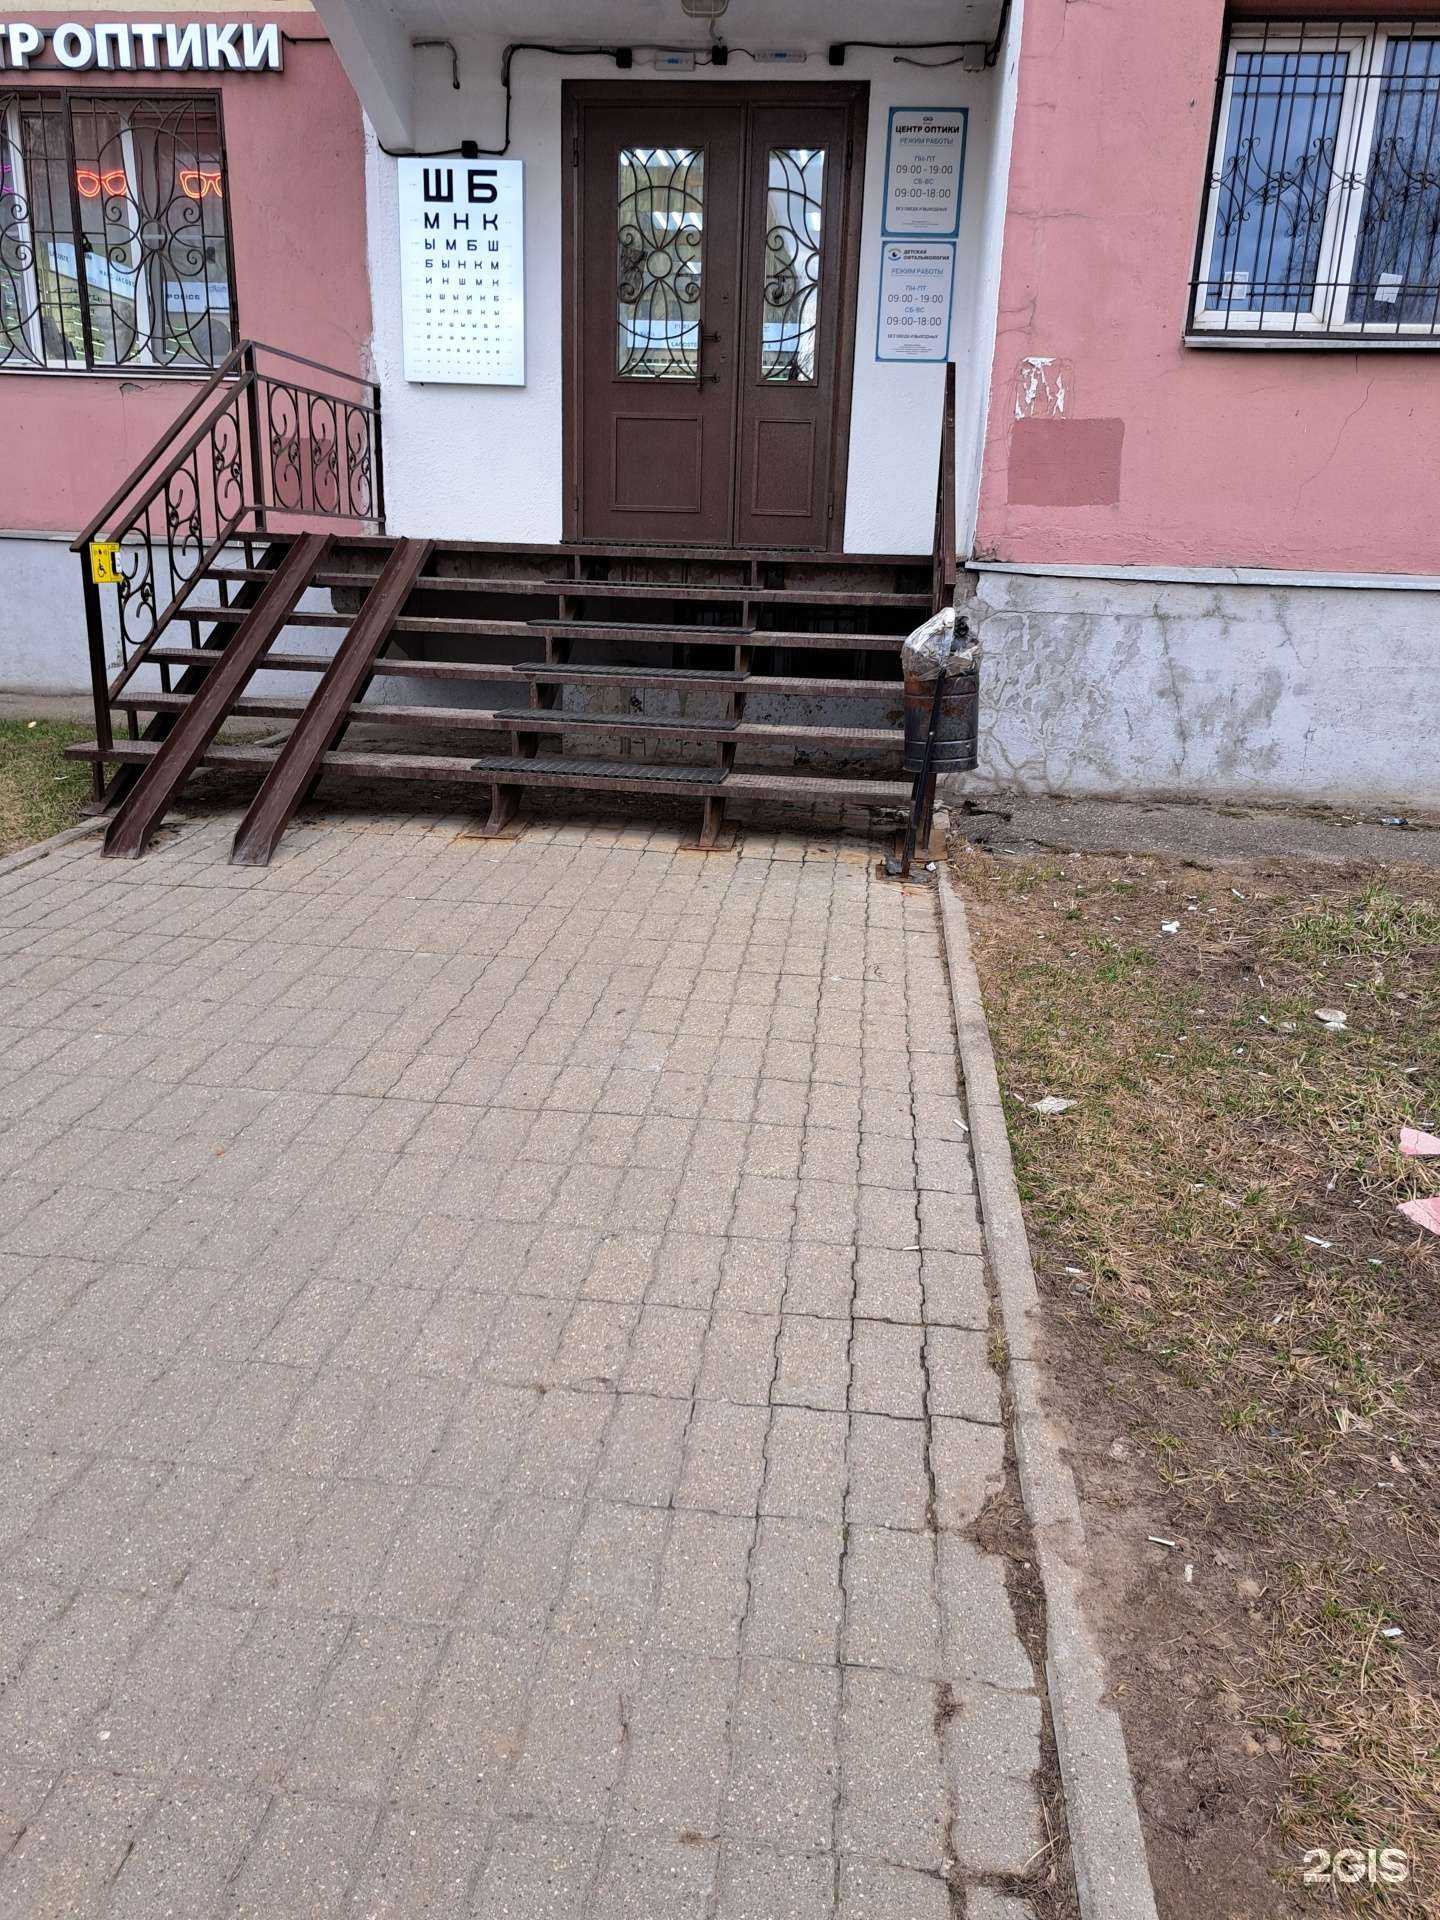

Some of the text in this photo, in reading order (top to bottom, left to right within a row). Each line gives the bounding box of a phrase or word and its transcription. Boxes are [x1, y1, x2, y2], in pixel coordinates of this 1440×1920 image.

[0, 23, 282, 70] Р ОПТИКИ
[895, 125, 960, 134] ЦЕНТР ОПТИКИ
[926, 137, 954, 145] РАБОТЫ
[896, 164, 922, 174] 09:00
[930, 164, 953, 175] 19:00
[423, 168, 498, 204] Ш Б
[424, 212, 498, 231] М Н К
[425, 238, 498, 252] Ы М Б Ш
[887, 294, 913, 303] 09:00
[920, 294, 944, 304] 19:00
[886, 316, 942, 326] 09:00-18:00
